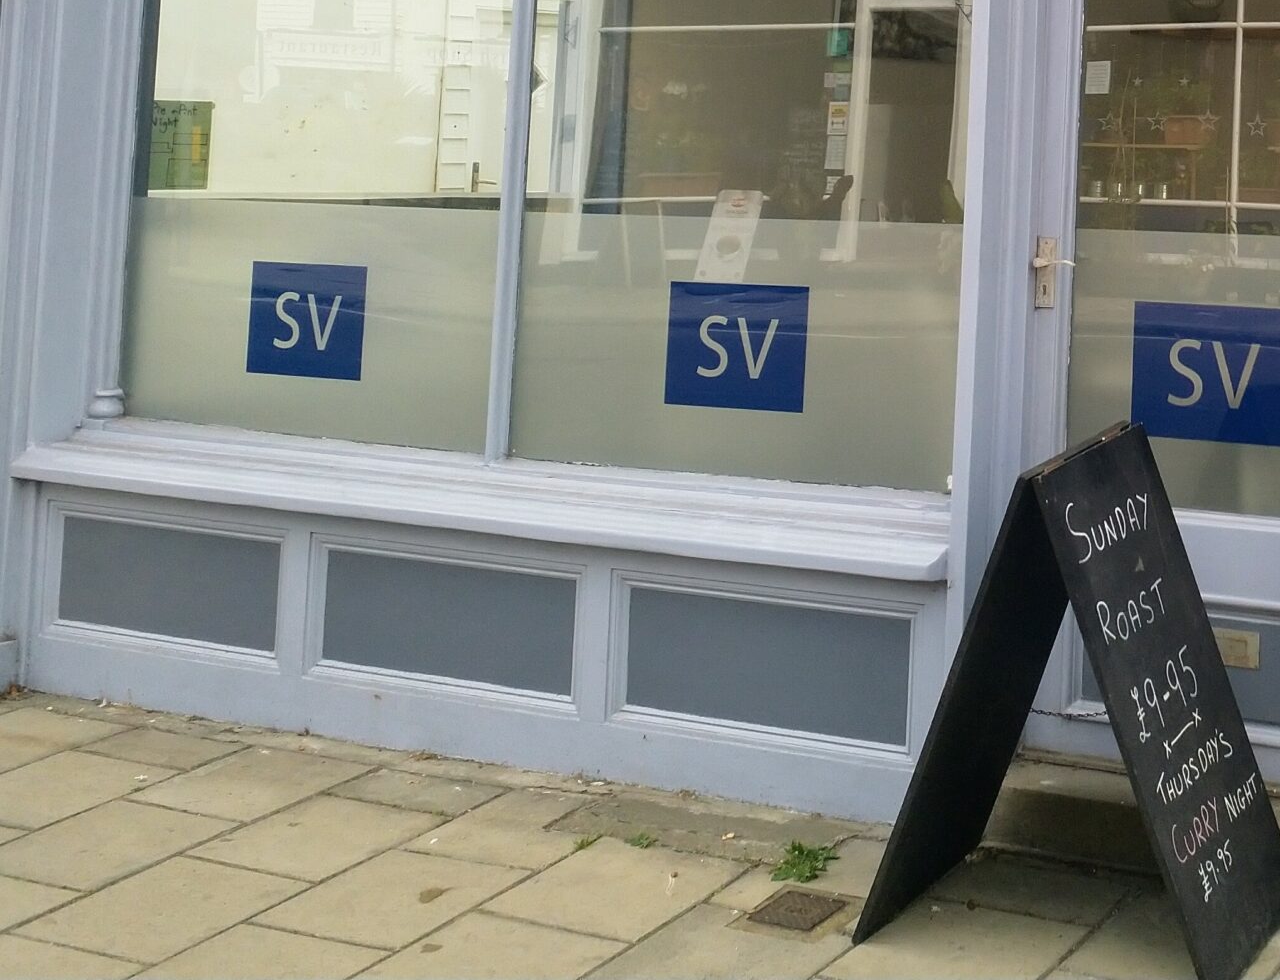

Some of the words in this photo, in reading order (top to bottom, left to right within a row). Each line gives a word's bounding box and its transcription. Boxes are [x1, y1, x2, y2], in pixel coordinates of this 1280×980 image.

[272, 291, 343, 352] SV
[695, 315, 780, 380] SV
[1167, 338, 1262, 410] SV
[1065, 492, 1148, 565] SUNDAY
[1096, 577, 1166, 646] ROAST
[1171, 796, 1220, 864] CURRY
[1198, 838, 1233, 903] £9.95
